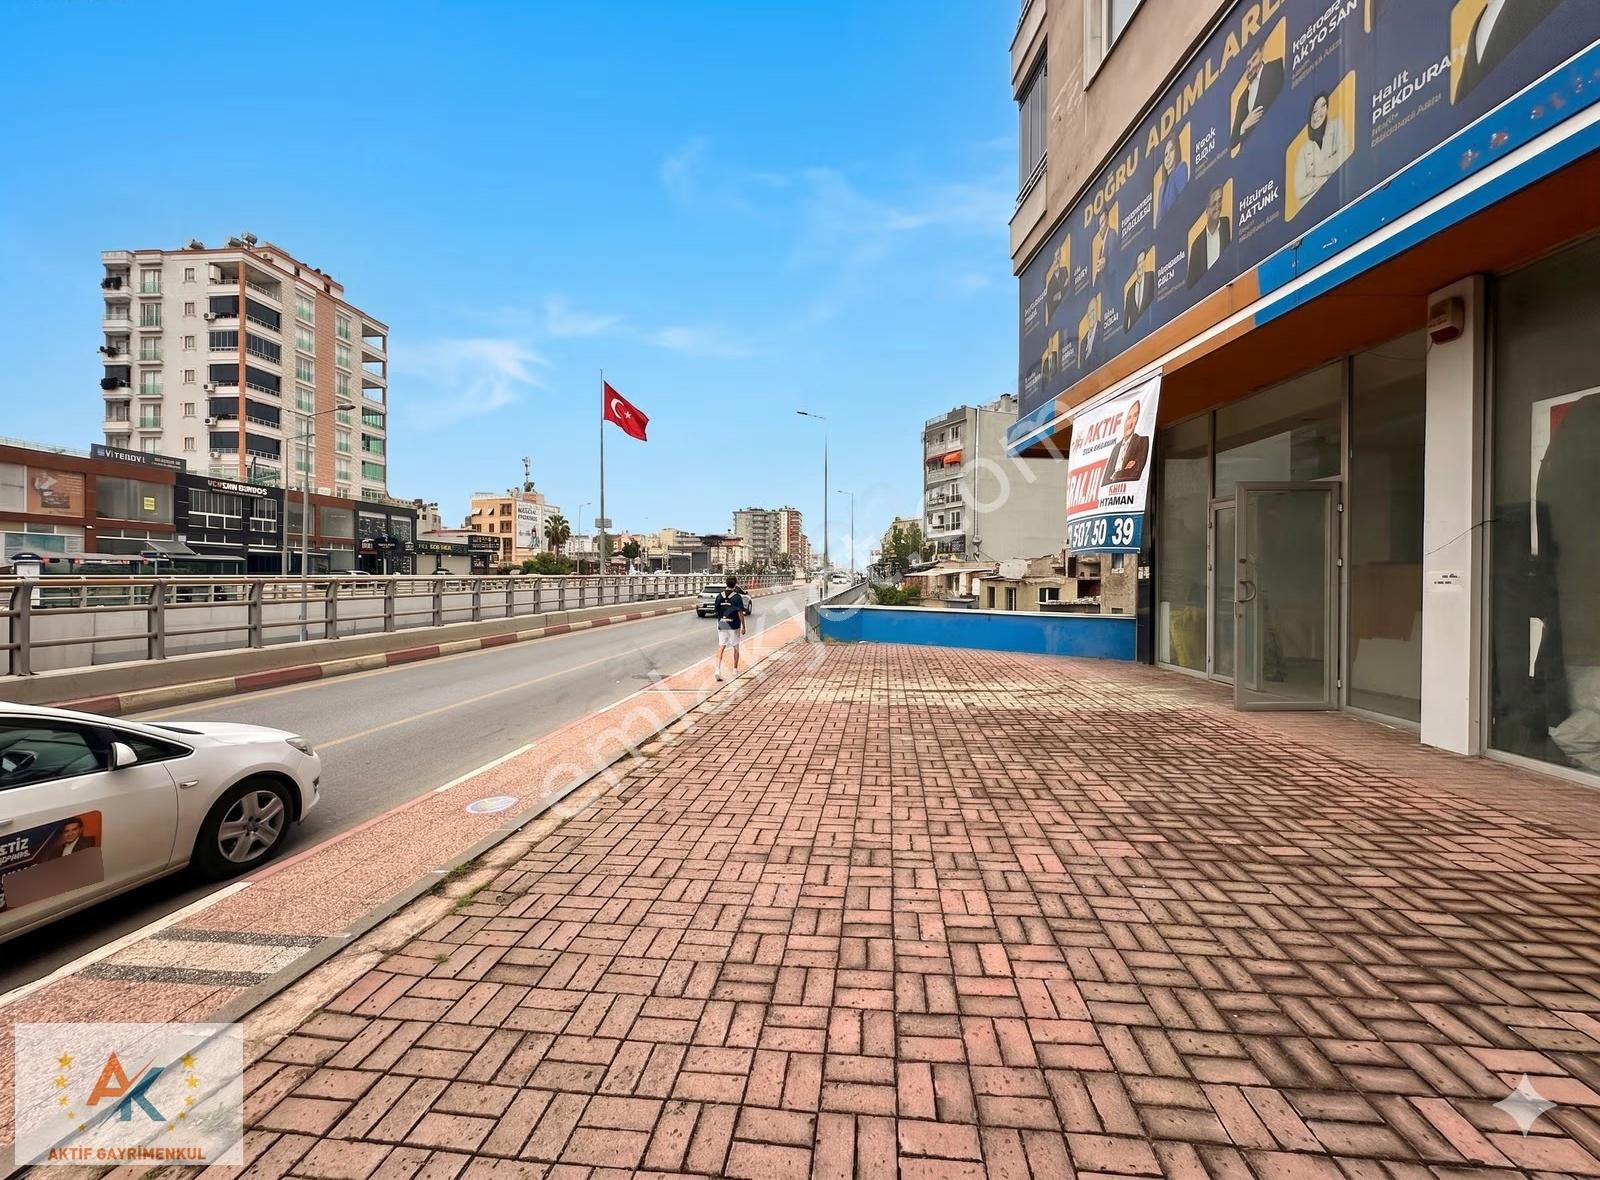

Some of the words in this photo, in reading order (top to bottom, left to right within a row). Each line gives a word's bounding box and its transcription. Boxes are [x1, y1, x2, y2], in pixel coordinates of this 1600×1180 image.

[1084, 147, 1138, 229] DOĞRU
[1091, 518, 1107, 546] 50
[1112, 517, 1134, 546] 39
